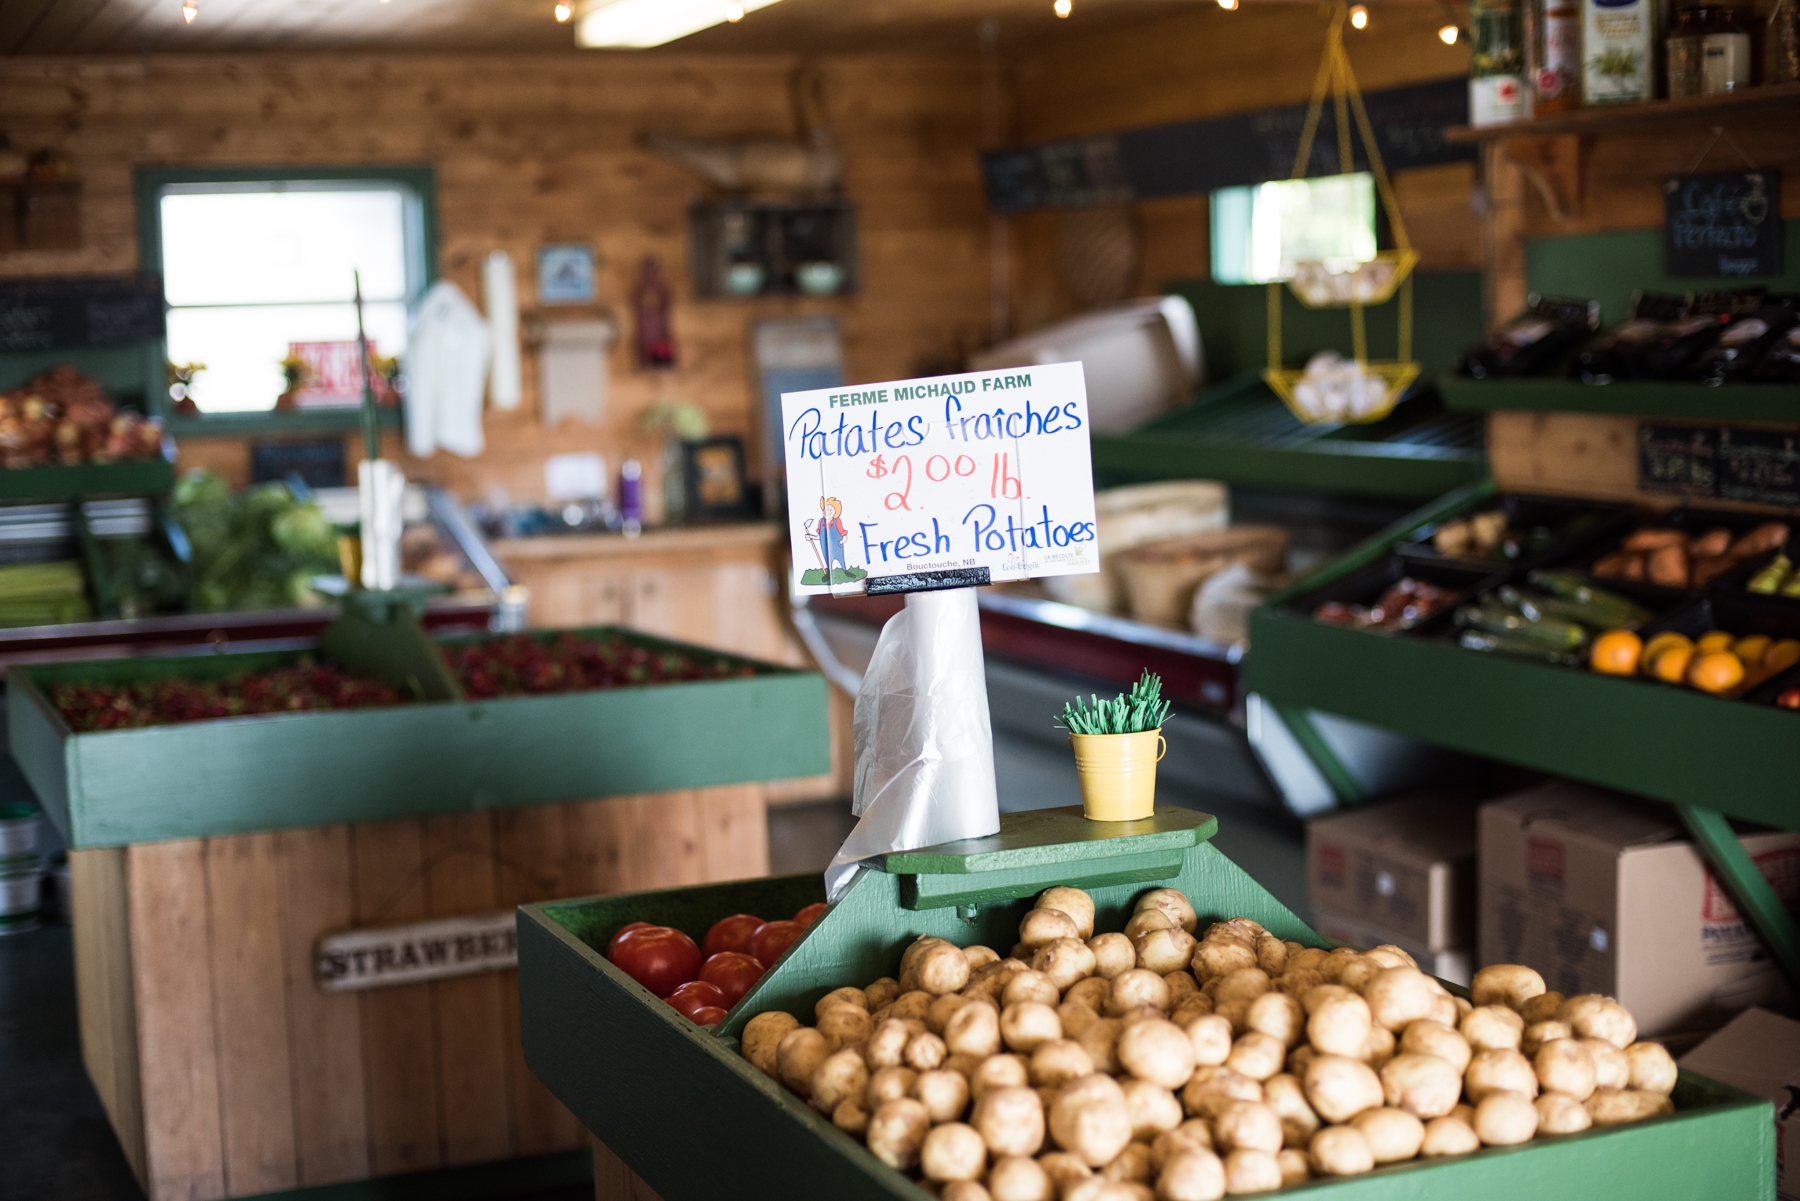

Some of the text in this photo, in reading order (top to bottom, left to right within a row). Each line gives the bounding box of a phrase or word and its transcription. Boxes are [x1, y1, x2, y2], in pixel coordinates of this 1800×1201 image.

[829, 374, 1032, 408] FERME MICHAUD FARM
[789, 394, 1081, 460] Patates fraîches
[859, 503, 1095, 565] Fresh Potatoes
[906, 558, 976, 571] Bouctouche, NB
